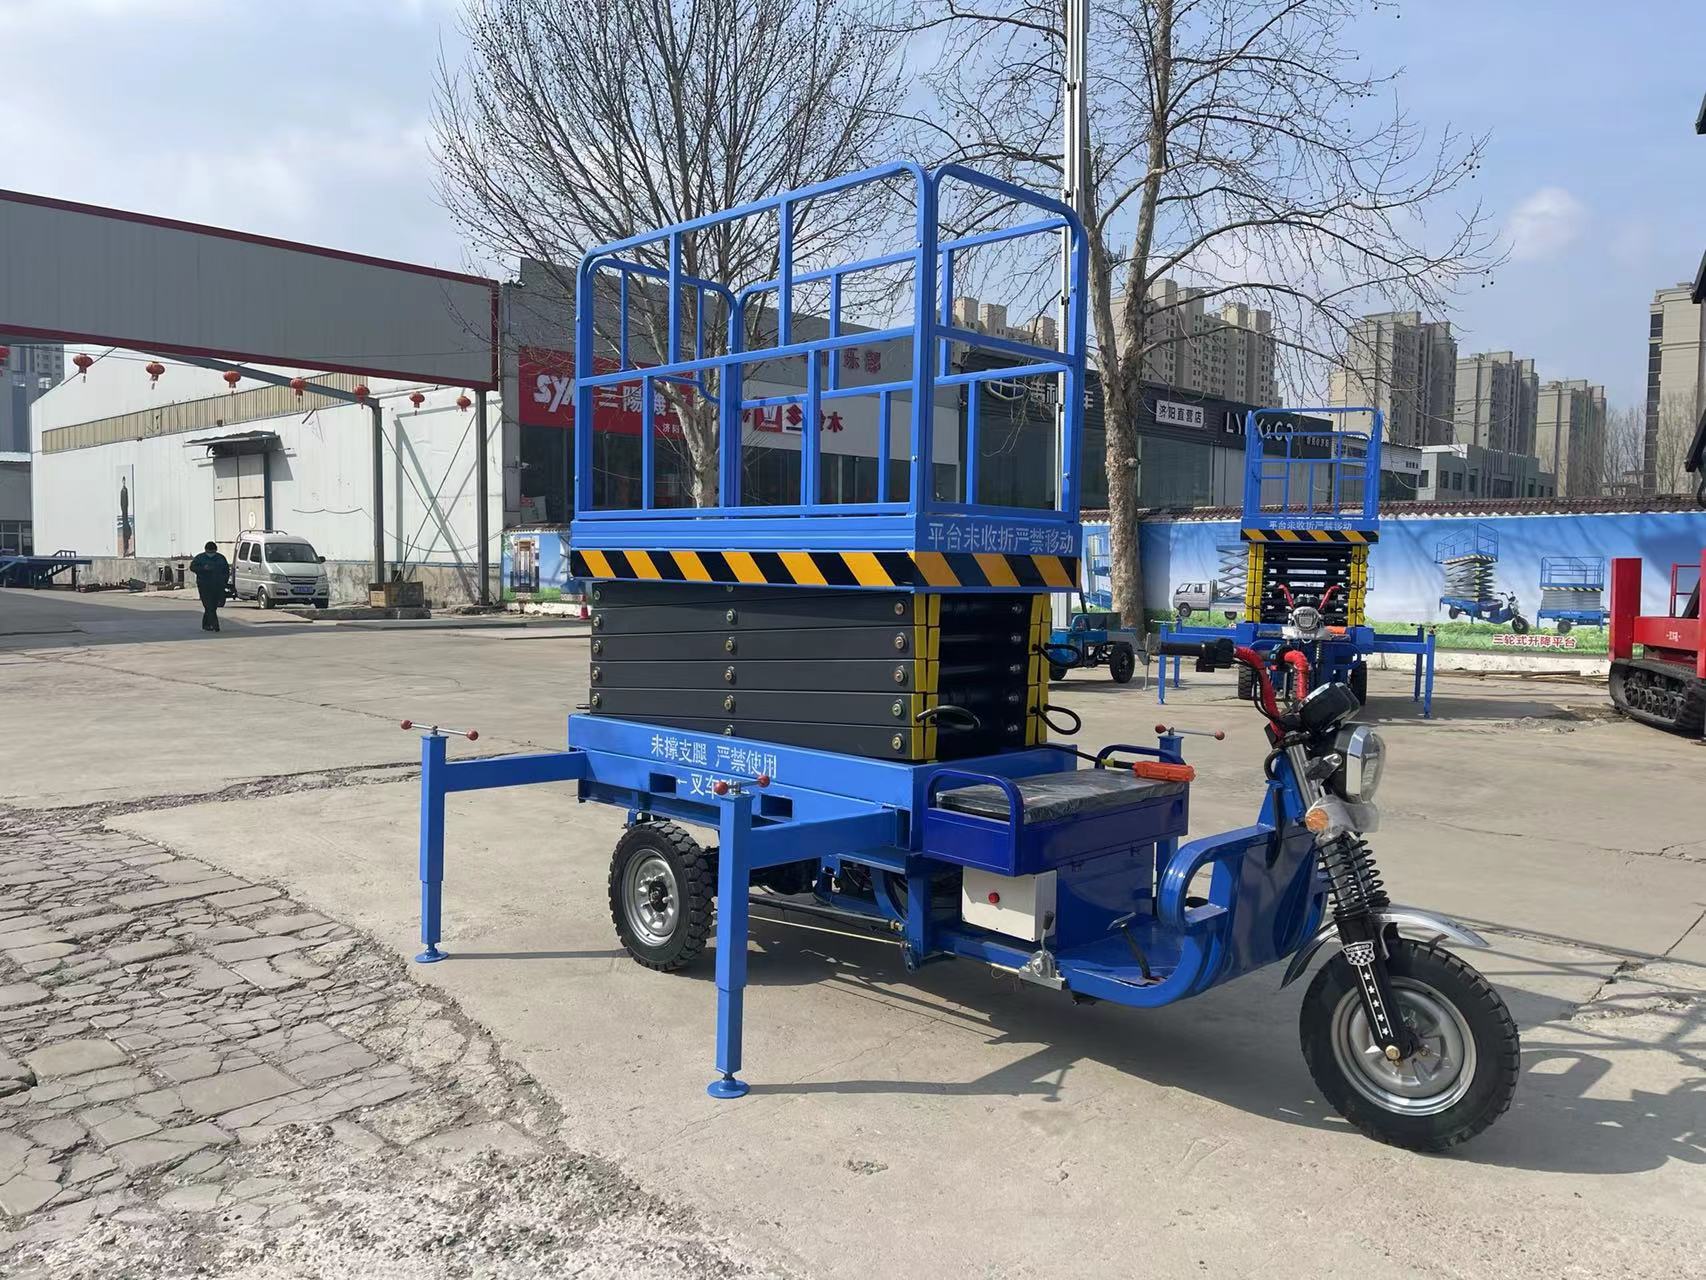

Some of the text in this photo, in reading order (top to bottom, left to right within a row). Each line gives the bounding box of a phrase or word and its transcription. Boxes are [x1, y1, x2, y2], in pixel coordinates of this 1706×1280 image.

[1031, 381, 1094, 409] 吉利车
[820, 410, 844, 433] 木
[1159, 405, 1202, 423] 济阳直营店
[928, 522, 1074, 553] 平台未收折严禁移动
[1493, 634, 1576, 648] 三轮式升降平台
[651, 734, 777, 779] 未撑支腿 严禁使用
